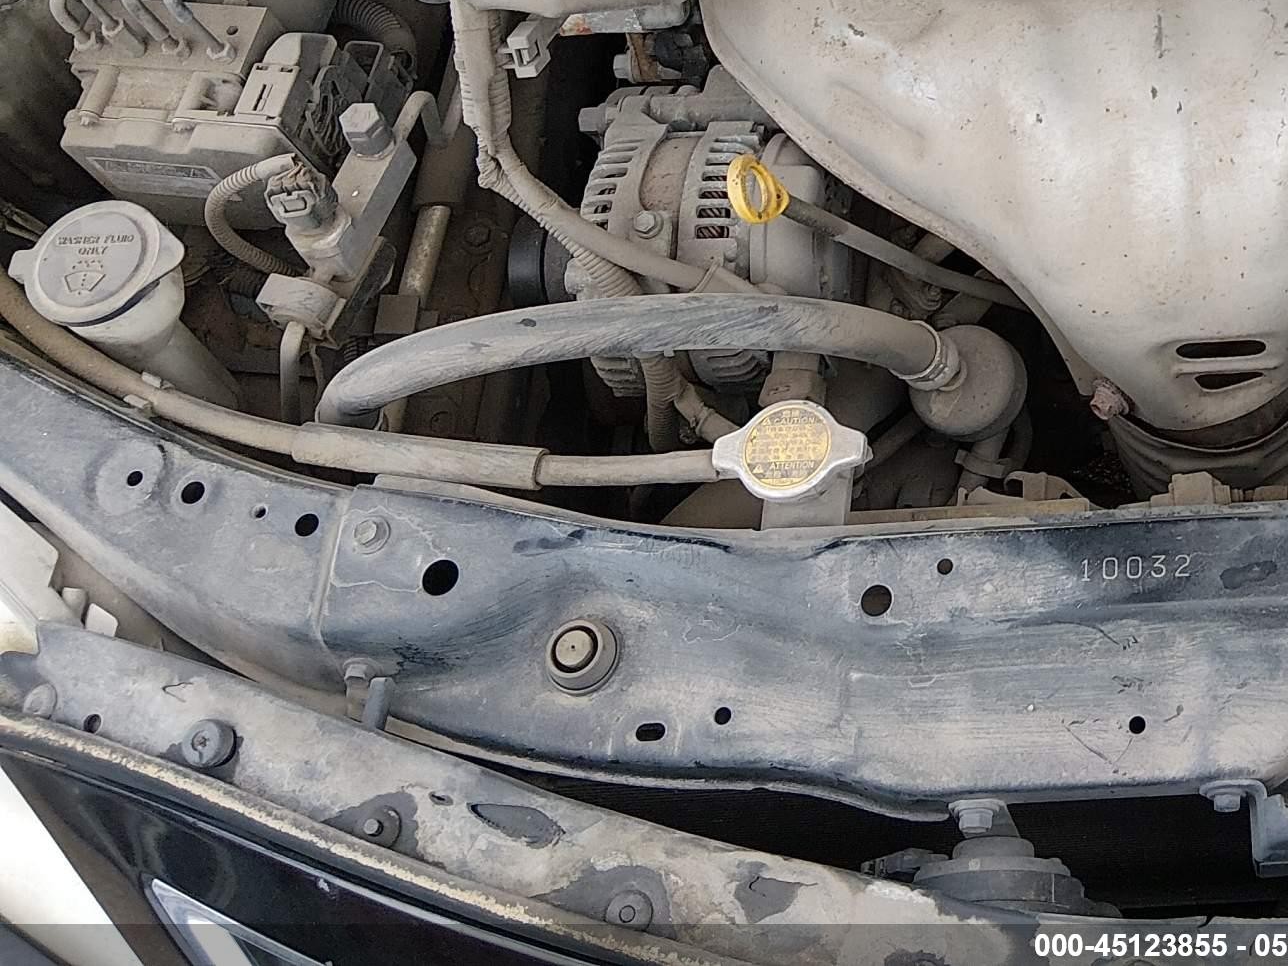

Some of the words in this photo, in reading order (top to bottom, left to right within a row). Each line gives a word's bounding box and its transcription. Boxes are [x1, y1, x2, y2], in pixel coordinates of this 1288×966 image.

[104, 234, 135, 244] FLUID
[774, 417, 816, 426] CAUTION
[769, 460, 815, 470] ATTENTION
[1080, 554, 1191, 582] 10032
